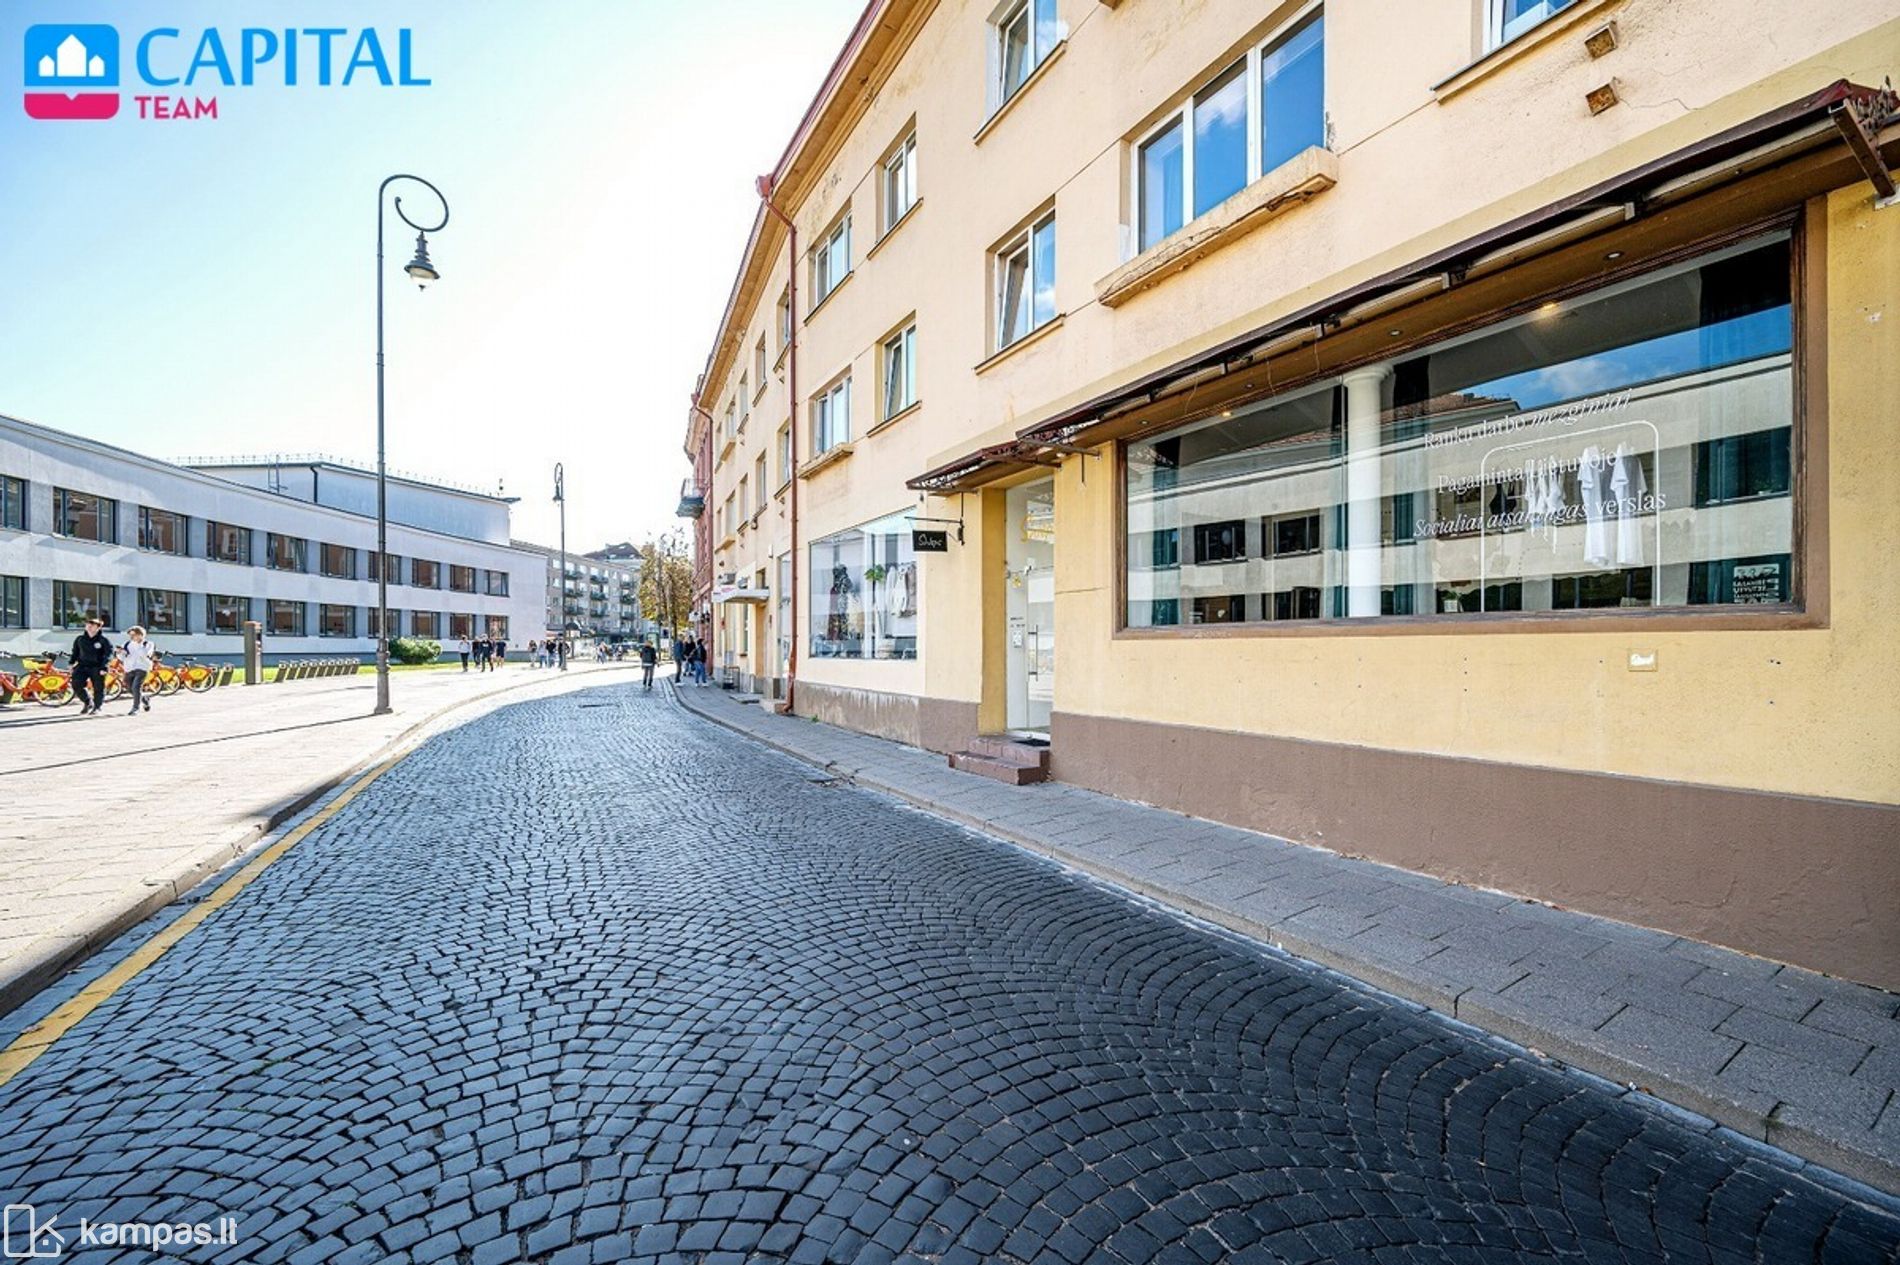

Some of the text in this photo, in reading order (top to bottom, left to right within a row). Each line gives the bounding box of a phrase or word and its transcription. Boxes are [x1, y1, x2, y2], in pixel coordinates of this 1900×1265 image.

[1479, 415, 1526, 438] darbo
[1438, 467, 1526, 495] Pagaminta
[1487, 504, 1587, 526] atsangas
[1595, 489, 1667, 515] verslas
